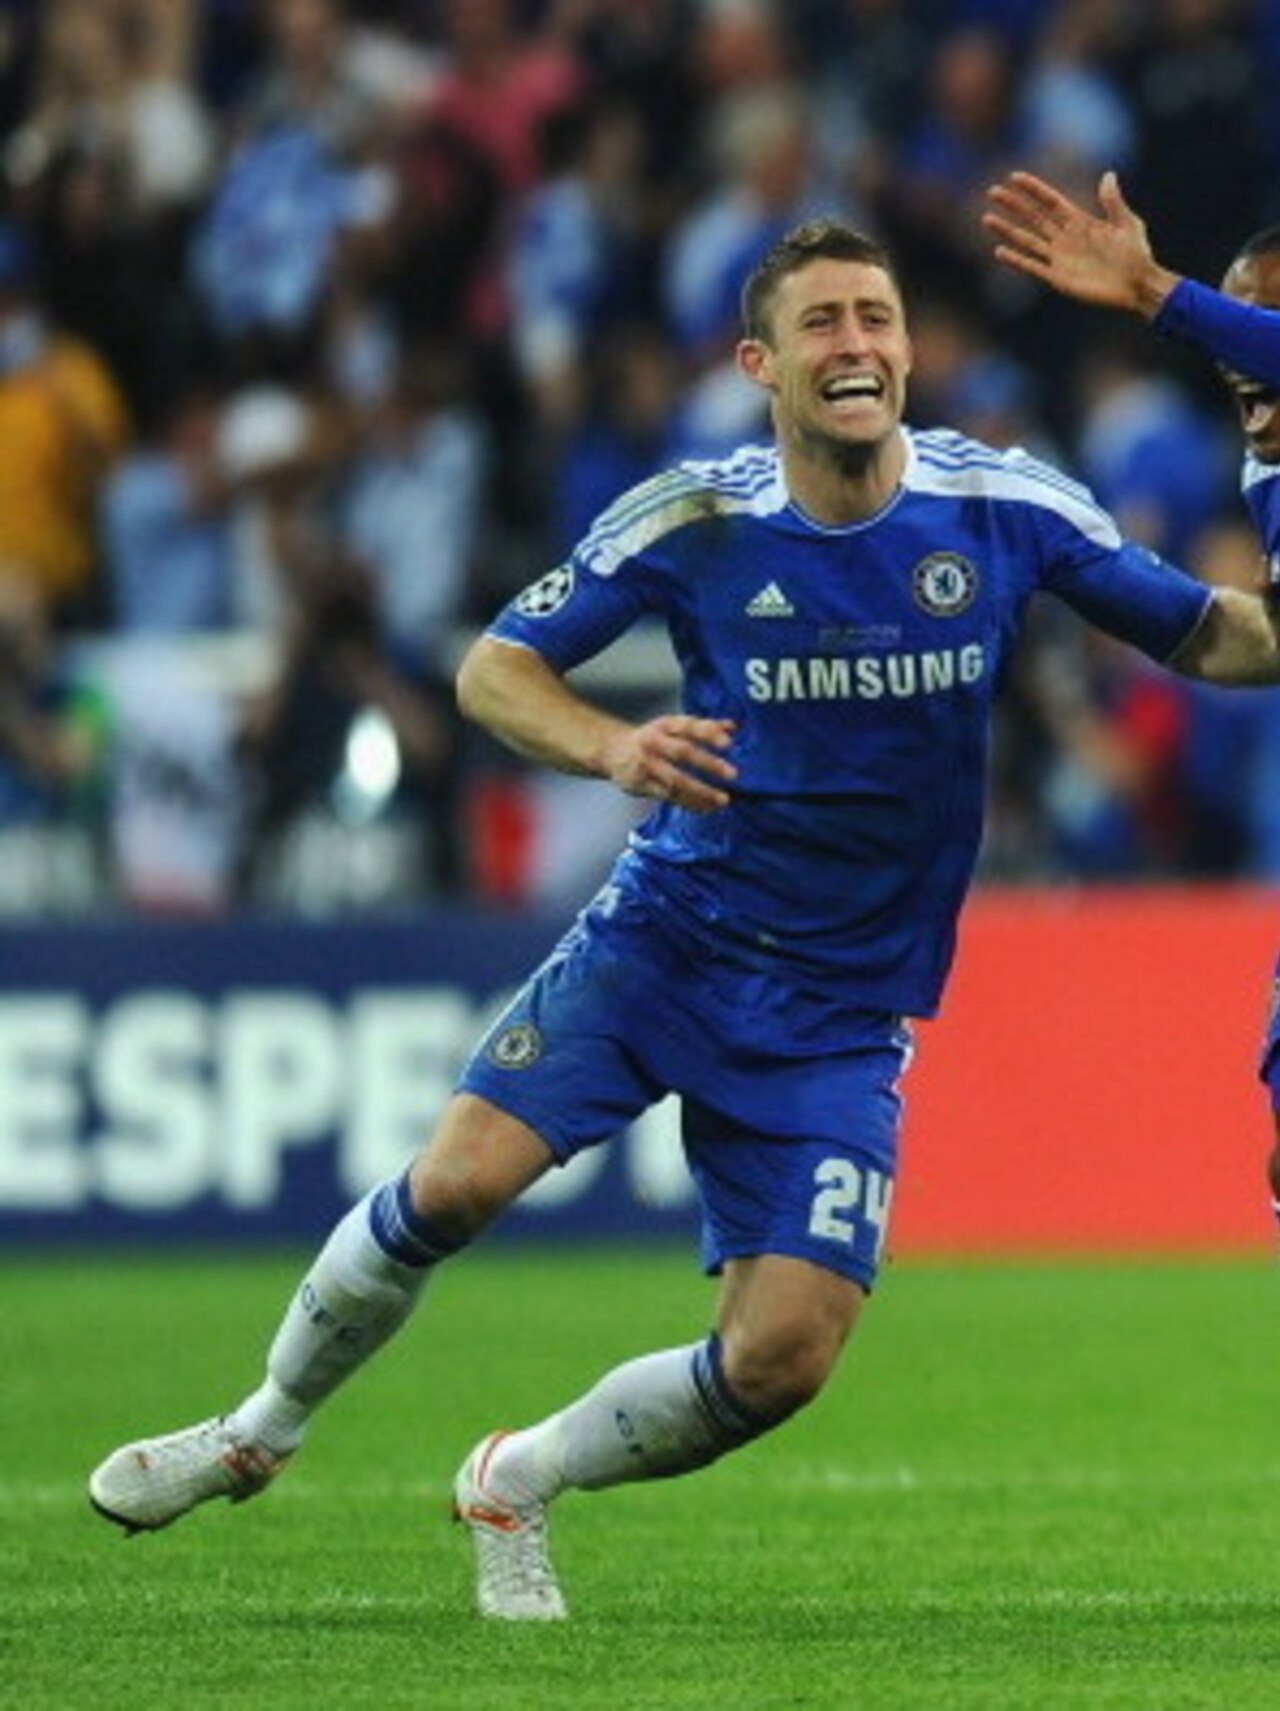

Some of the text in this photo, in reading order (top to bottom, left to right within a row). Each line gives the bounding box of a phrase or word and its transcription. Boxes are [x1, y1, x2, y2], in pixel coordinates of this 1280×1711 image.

[745, 642, 984, 703] SAMSUNG
[0, 990, 700, 1211] ESPE
[809, 1157, 893, 1244] 24
